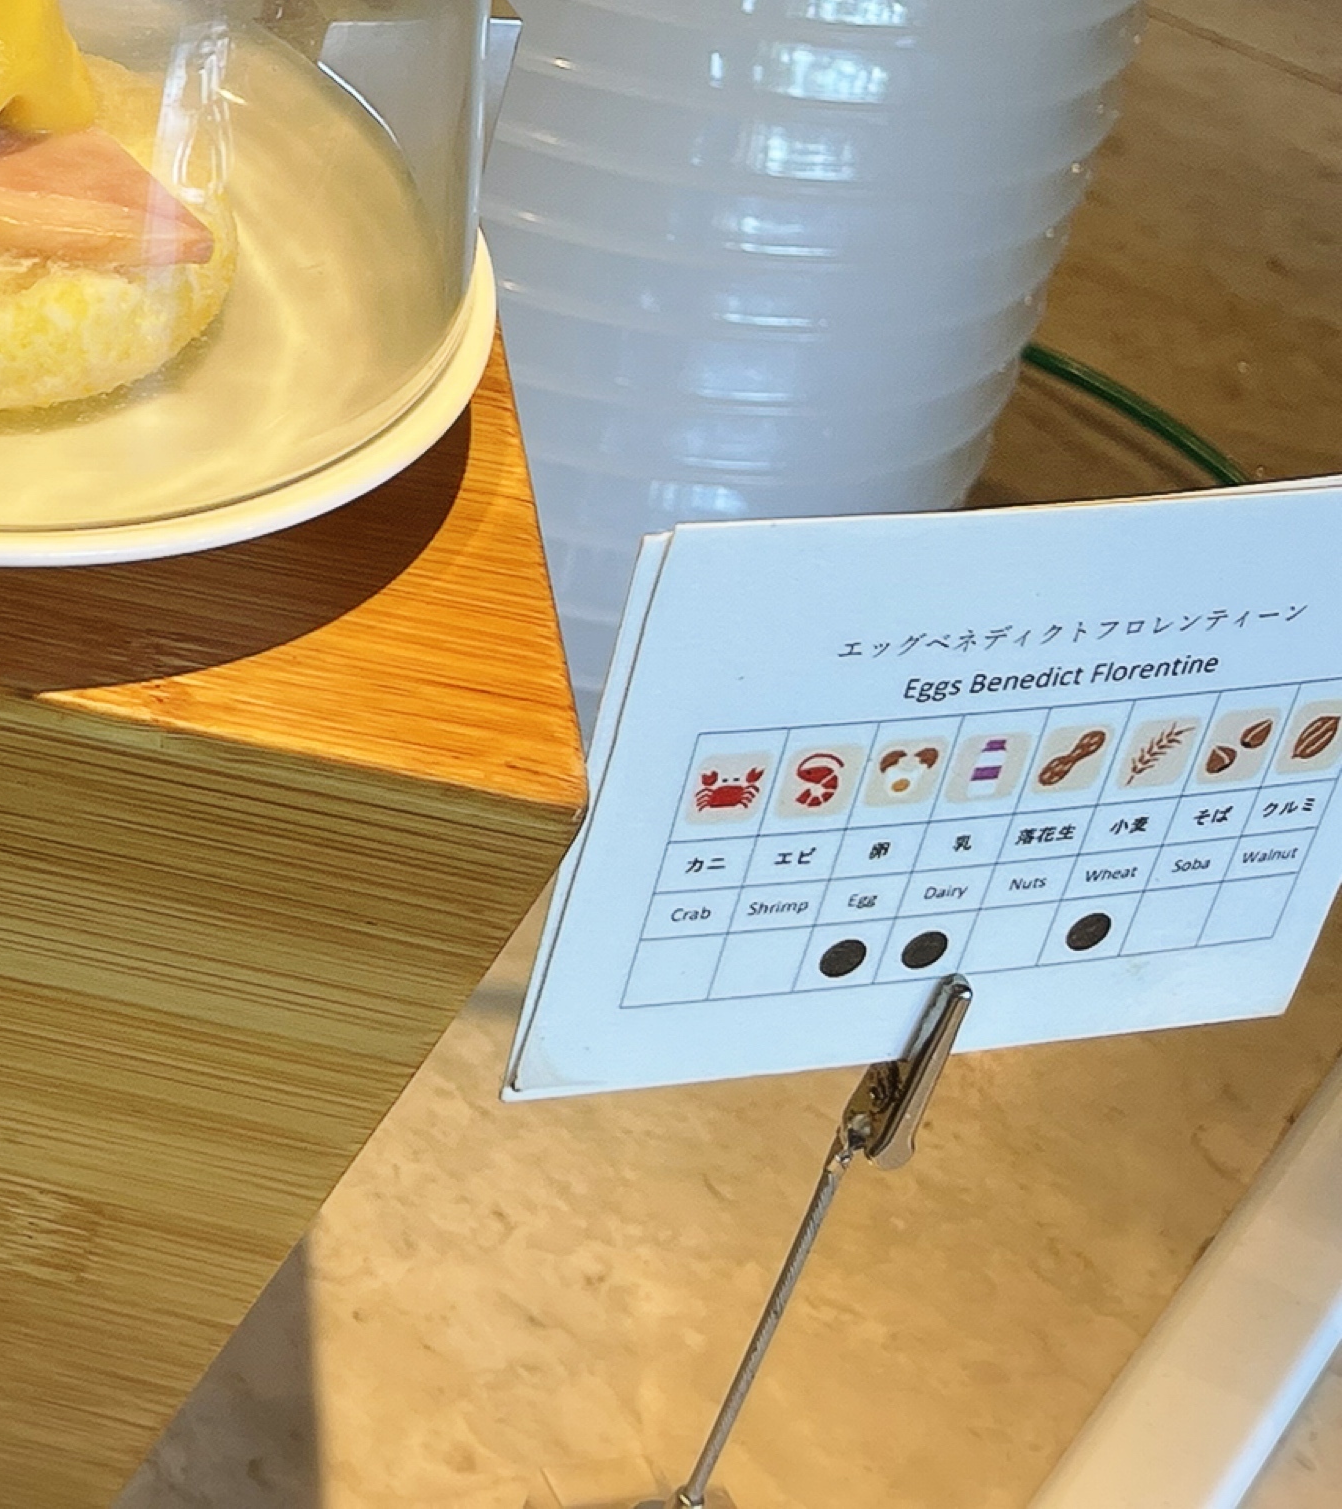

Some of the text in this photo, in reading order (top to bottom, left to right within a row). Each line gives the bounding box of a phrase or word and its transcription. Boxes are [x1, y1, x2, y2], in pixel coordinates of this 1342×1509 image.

[902, 654, 1219, 703] Eggs Benedict Florentine
[1192, 804, 1235, 827] そば
[1261, 796, 1317, 819] クルミ
[1015, 824, 1077, 846] 落花生
[1109, 815, 1151, 836] 小麦
[1241, 845, 1300, 865] Walnut
[684, 856, 727, 875] カニ
[1084, 865, 1139, 884] Wheat
[1171, 856, 1212, 874] Soba
[922, 884, 969, 902] Dairy
[1008, 876, 1048, 892] Nuts
[747, 898, 810, 918] Shrimp
[846, 892, 879, 910] Egg
[670, 906, 713, 923] Crab
